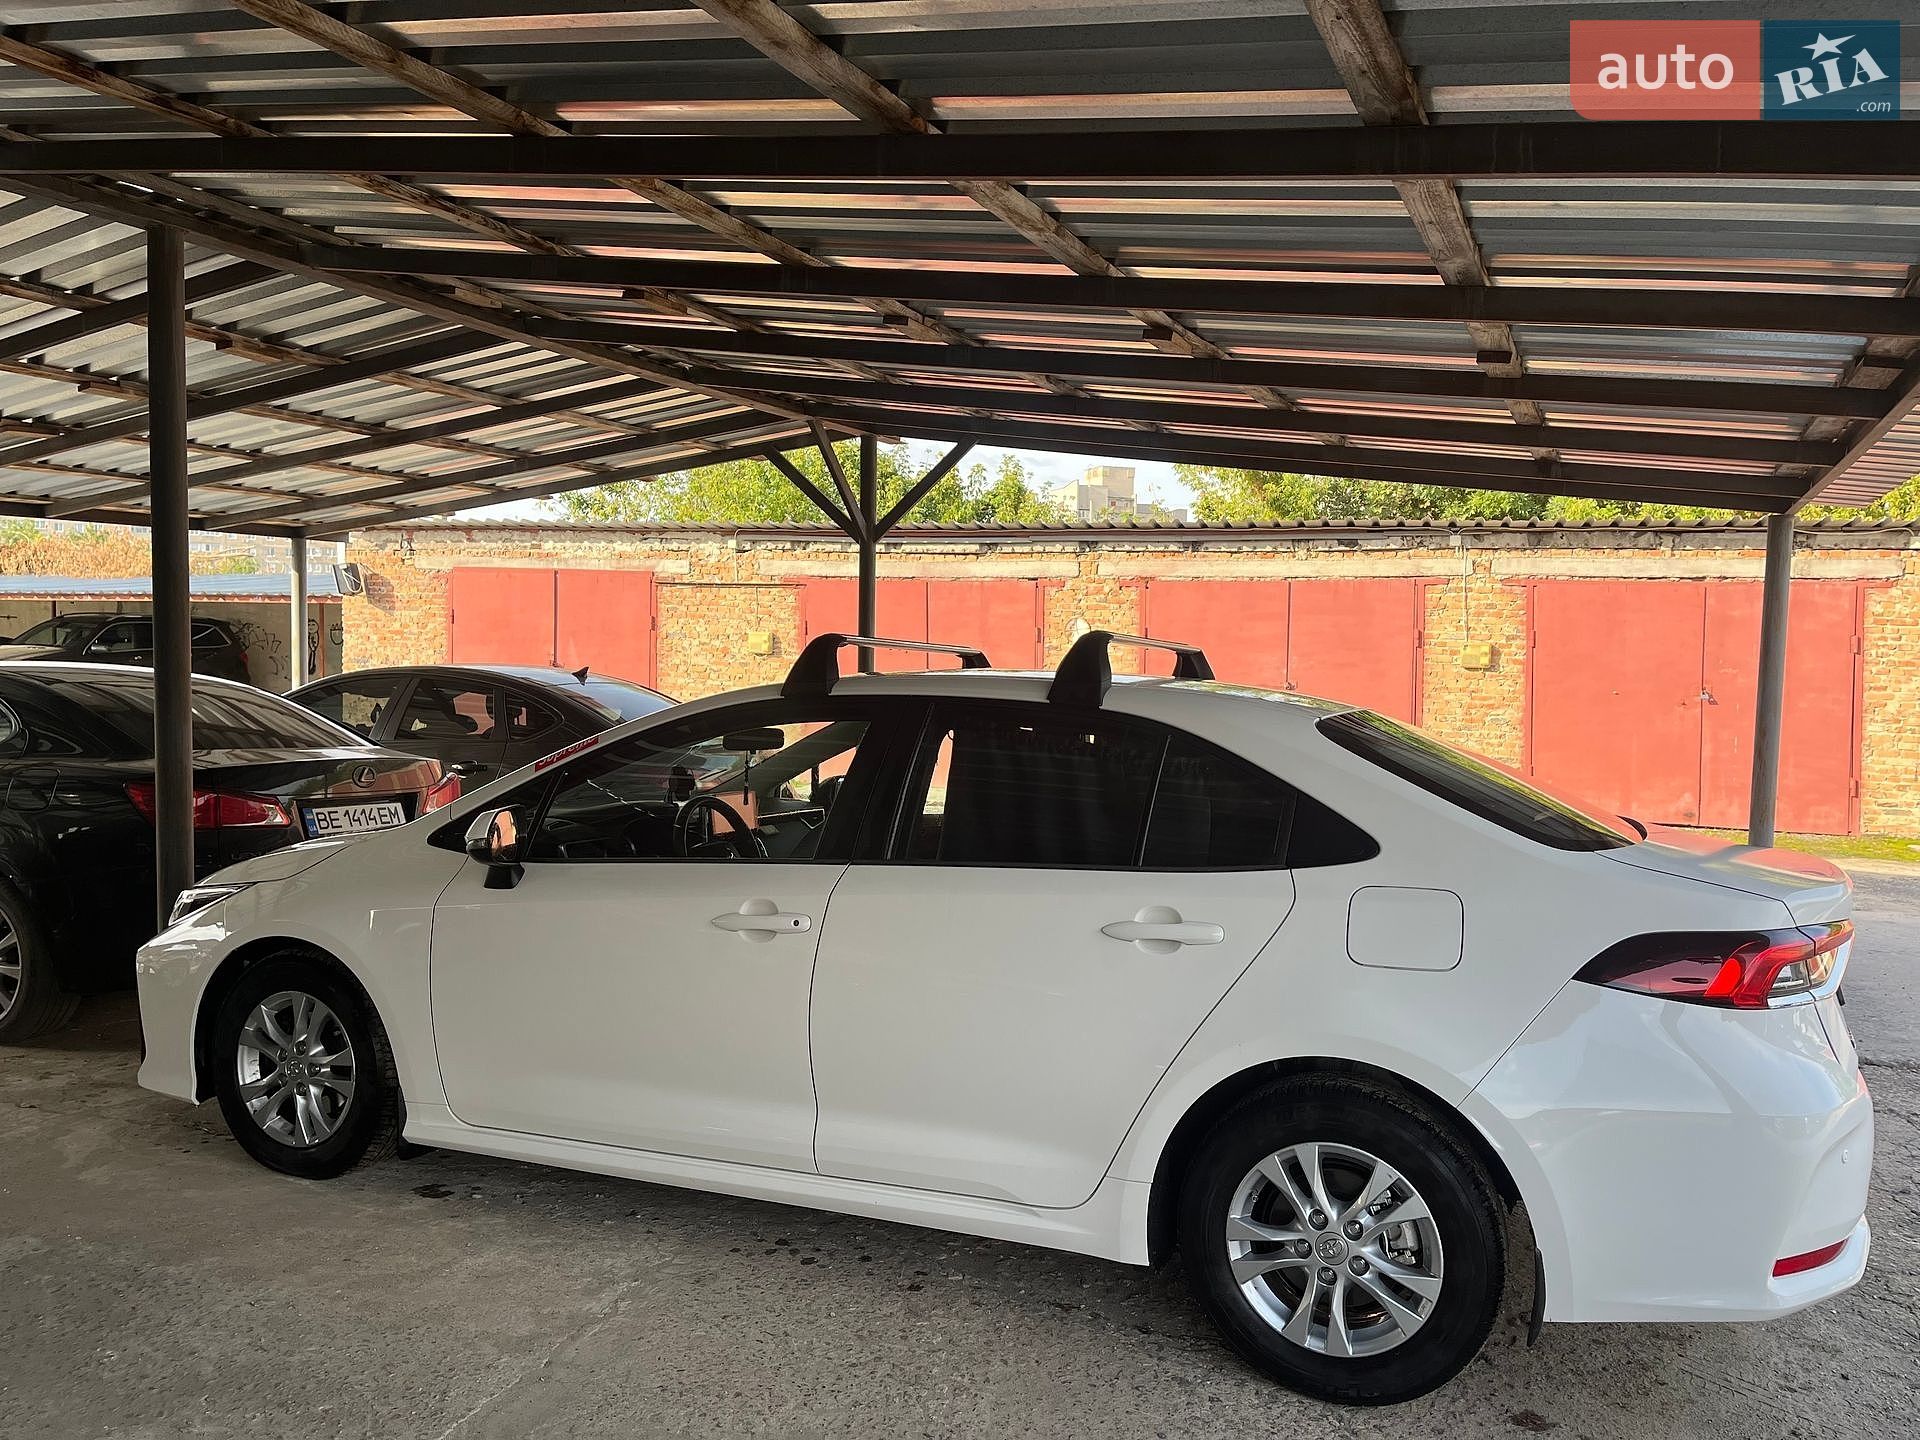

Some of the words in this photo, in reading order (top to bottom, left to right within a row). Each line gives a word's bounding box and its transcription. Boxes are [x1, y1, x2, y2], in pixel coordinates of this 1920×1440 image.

[316, 811, 342, 830] BE
[343, 808, 378, 827] 1414
[377, 806, 401, 825] EM
